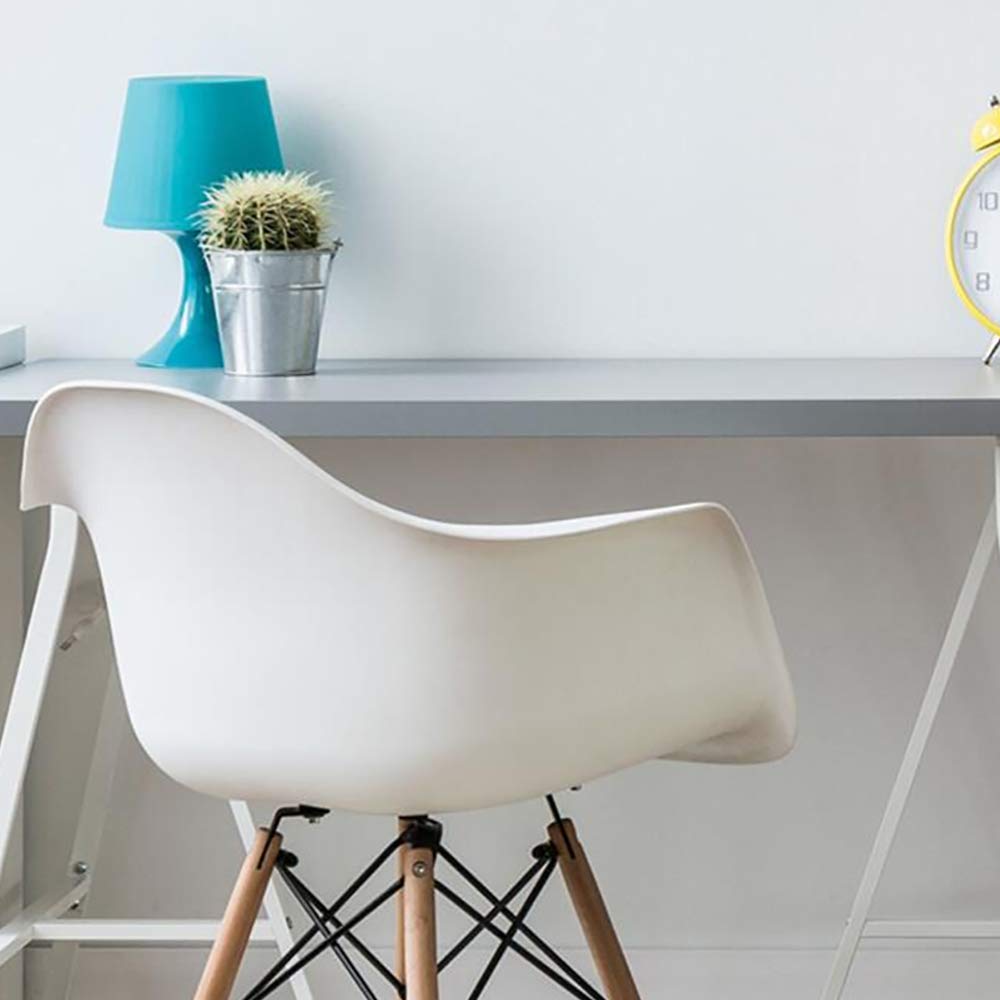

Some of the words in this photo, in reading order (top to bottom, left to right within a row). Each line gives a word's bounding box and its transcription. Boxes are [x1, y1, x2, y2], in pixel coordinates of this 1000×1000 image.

[978, 191, 999, 211] 10
[964, 231, 978, 250] 9
[976, 272, 990, 291] 8
